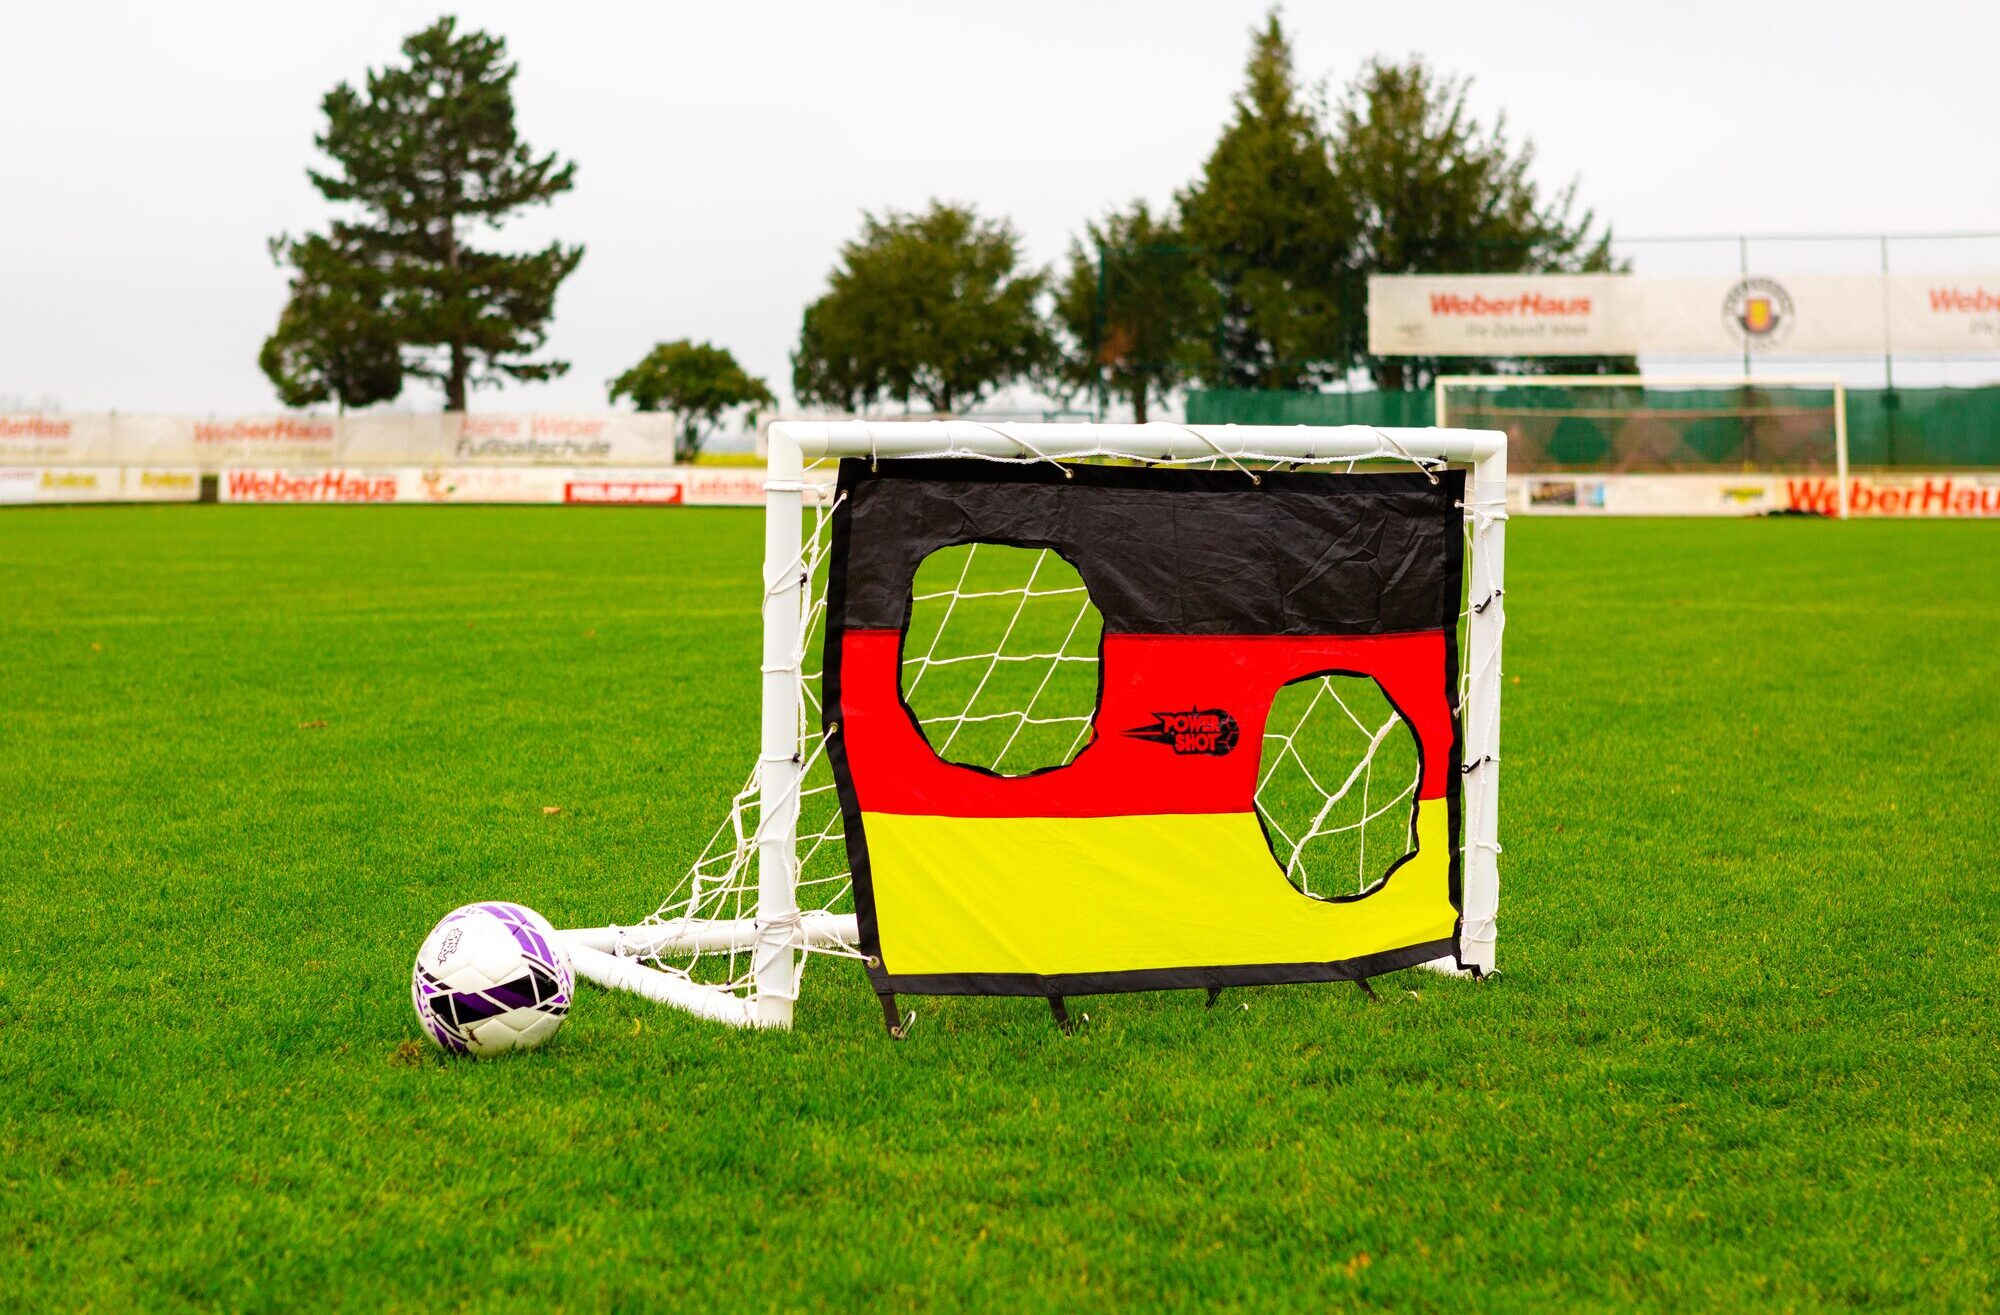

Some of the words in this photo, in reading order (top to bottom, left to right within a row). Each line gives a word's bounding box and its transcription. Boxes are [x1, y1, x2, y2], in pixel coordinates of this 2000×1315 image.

[1429, 292, 1591, 316] WeberHaus
[228, 468, 397, 501] WeberHaus
[1161, 714, 1222, 733] POWER
[1175, 733, 1222, 752] SHOT
